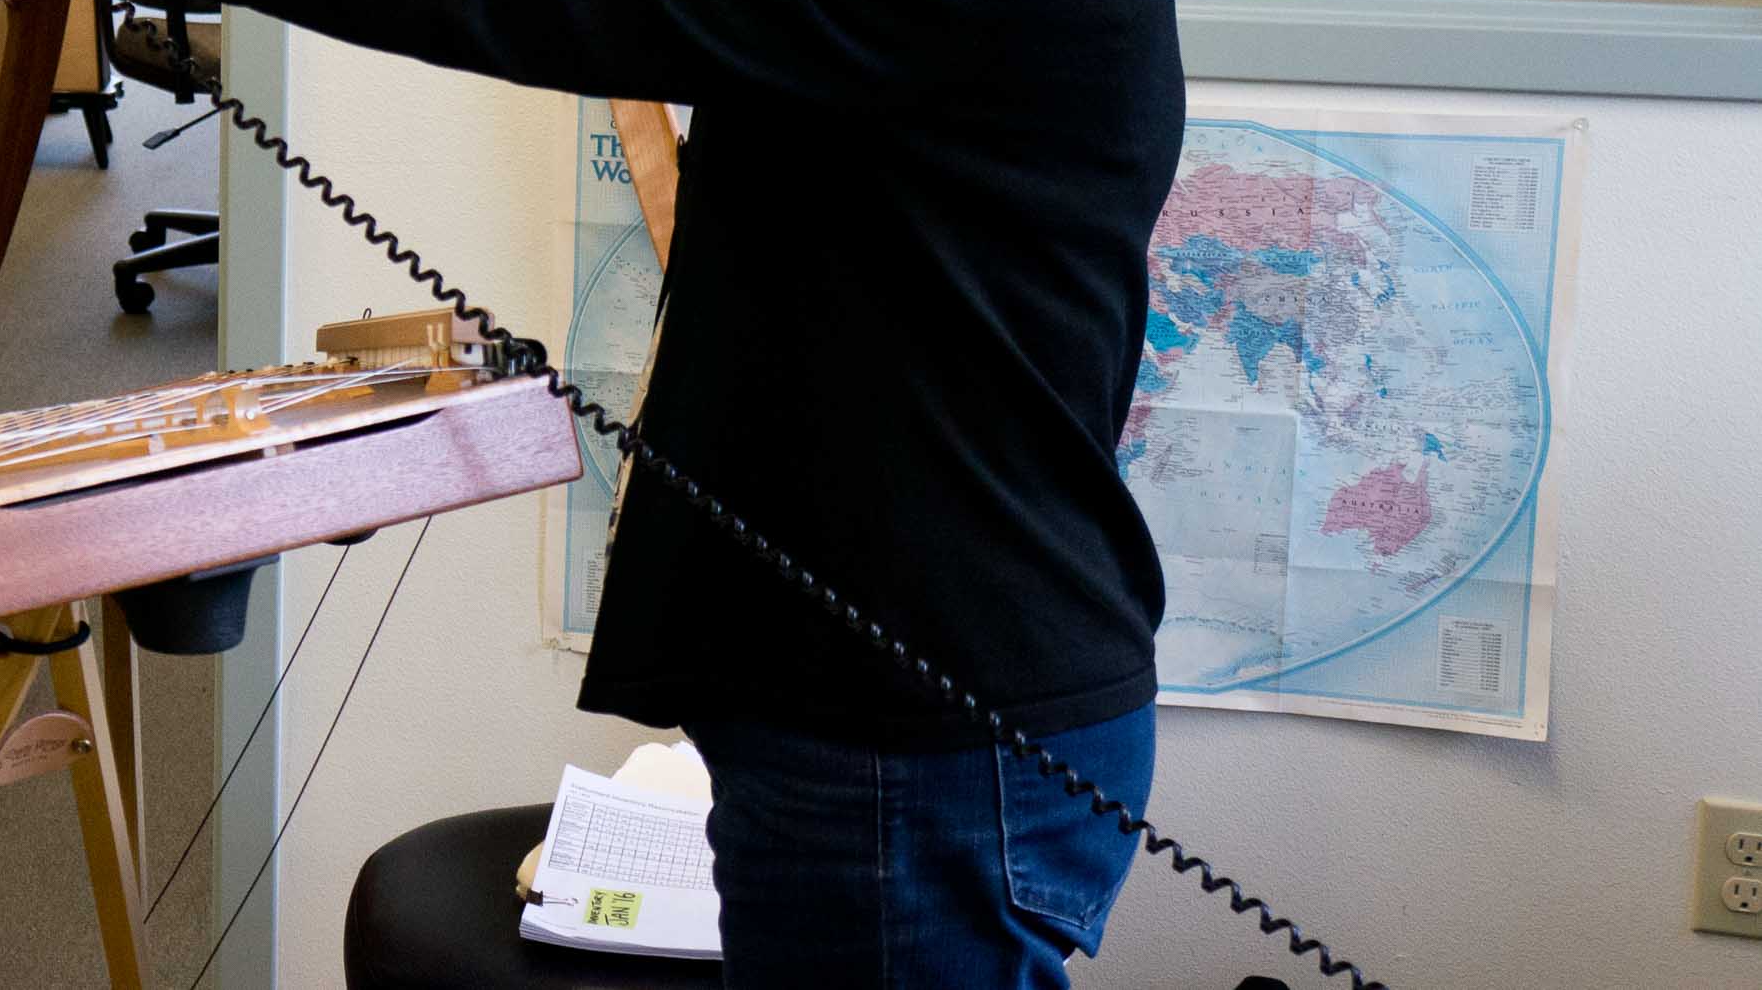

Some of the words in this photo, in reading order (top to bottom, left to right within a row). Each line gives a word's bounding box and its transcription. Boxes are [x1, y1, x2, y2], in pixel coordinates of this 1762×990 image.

[1162, 206, 1305, 218] RUSSIA
[1341, 498, 1422, 515] AUSTRALIA
[604, 906, 631, 926] JAN
